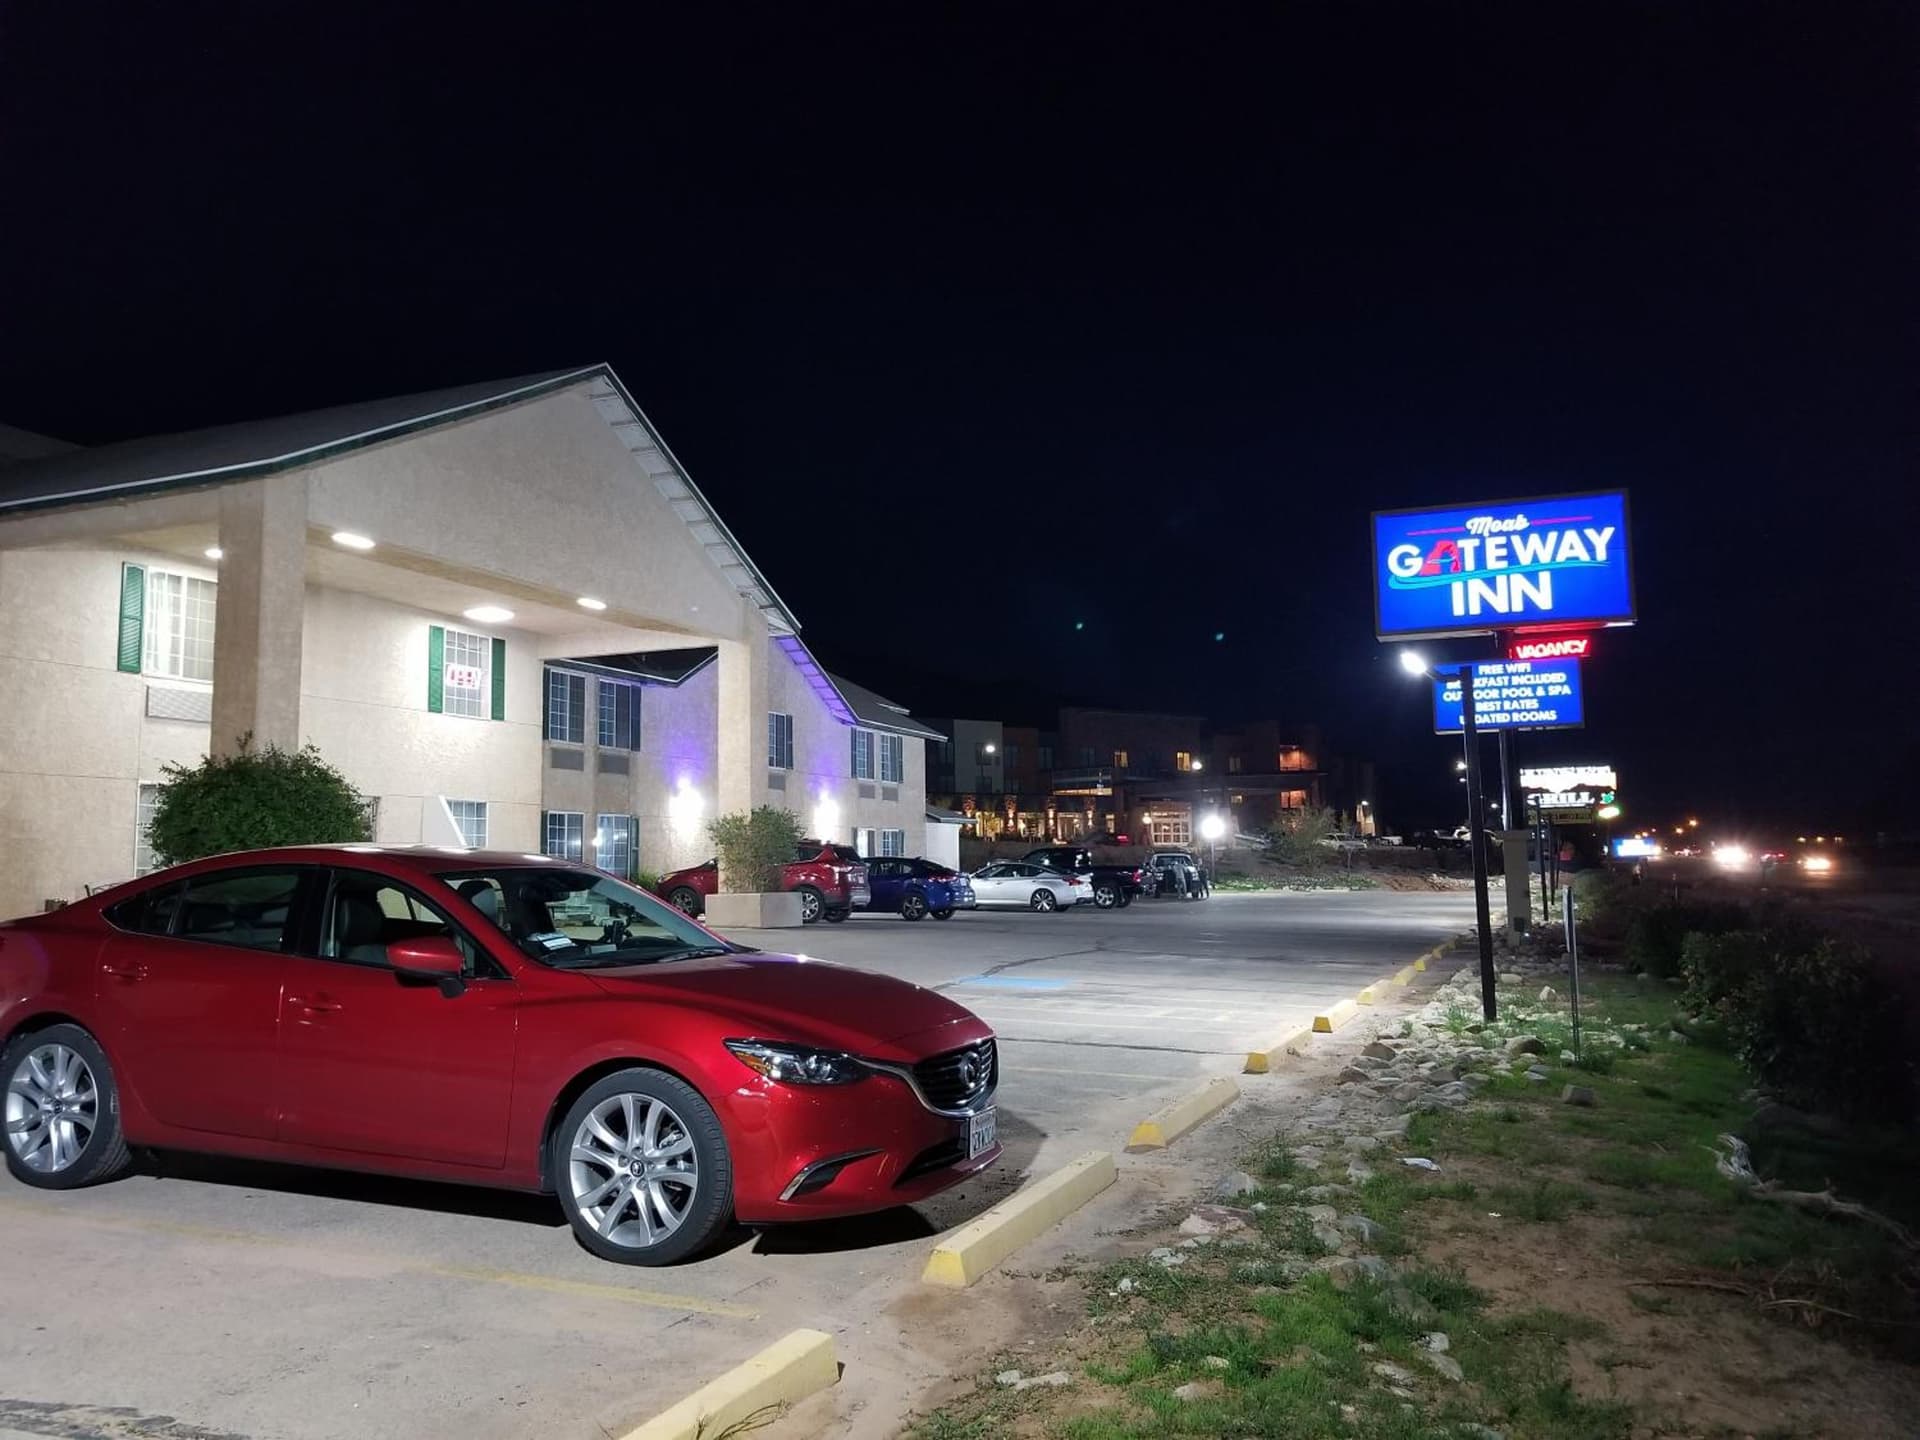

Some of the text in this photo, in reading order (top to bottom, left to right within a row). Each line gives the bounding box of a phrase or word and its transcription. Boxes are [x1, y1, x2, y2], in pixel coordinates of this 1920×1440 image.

[1465, 514, 1530, 536] Moab
[1387, 526, 1616, 577] GATEWAY
[1451, 570, 1553, 616] INN
[1515, 639, 1588, 659] VACANCY
[1478, 665, 1504, 675] FREE
[1511, 673, 1567, 686] INCLUDED
[1443, 685, 1572, 702] OUTOOR POOL & SPA
[1475, 699, 1539, 712] BEST RATES
[1512, 710, 1557, 722] ROOMS
